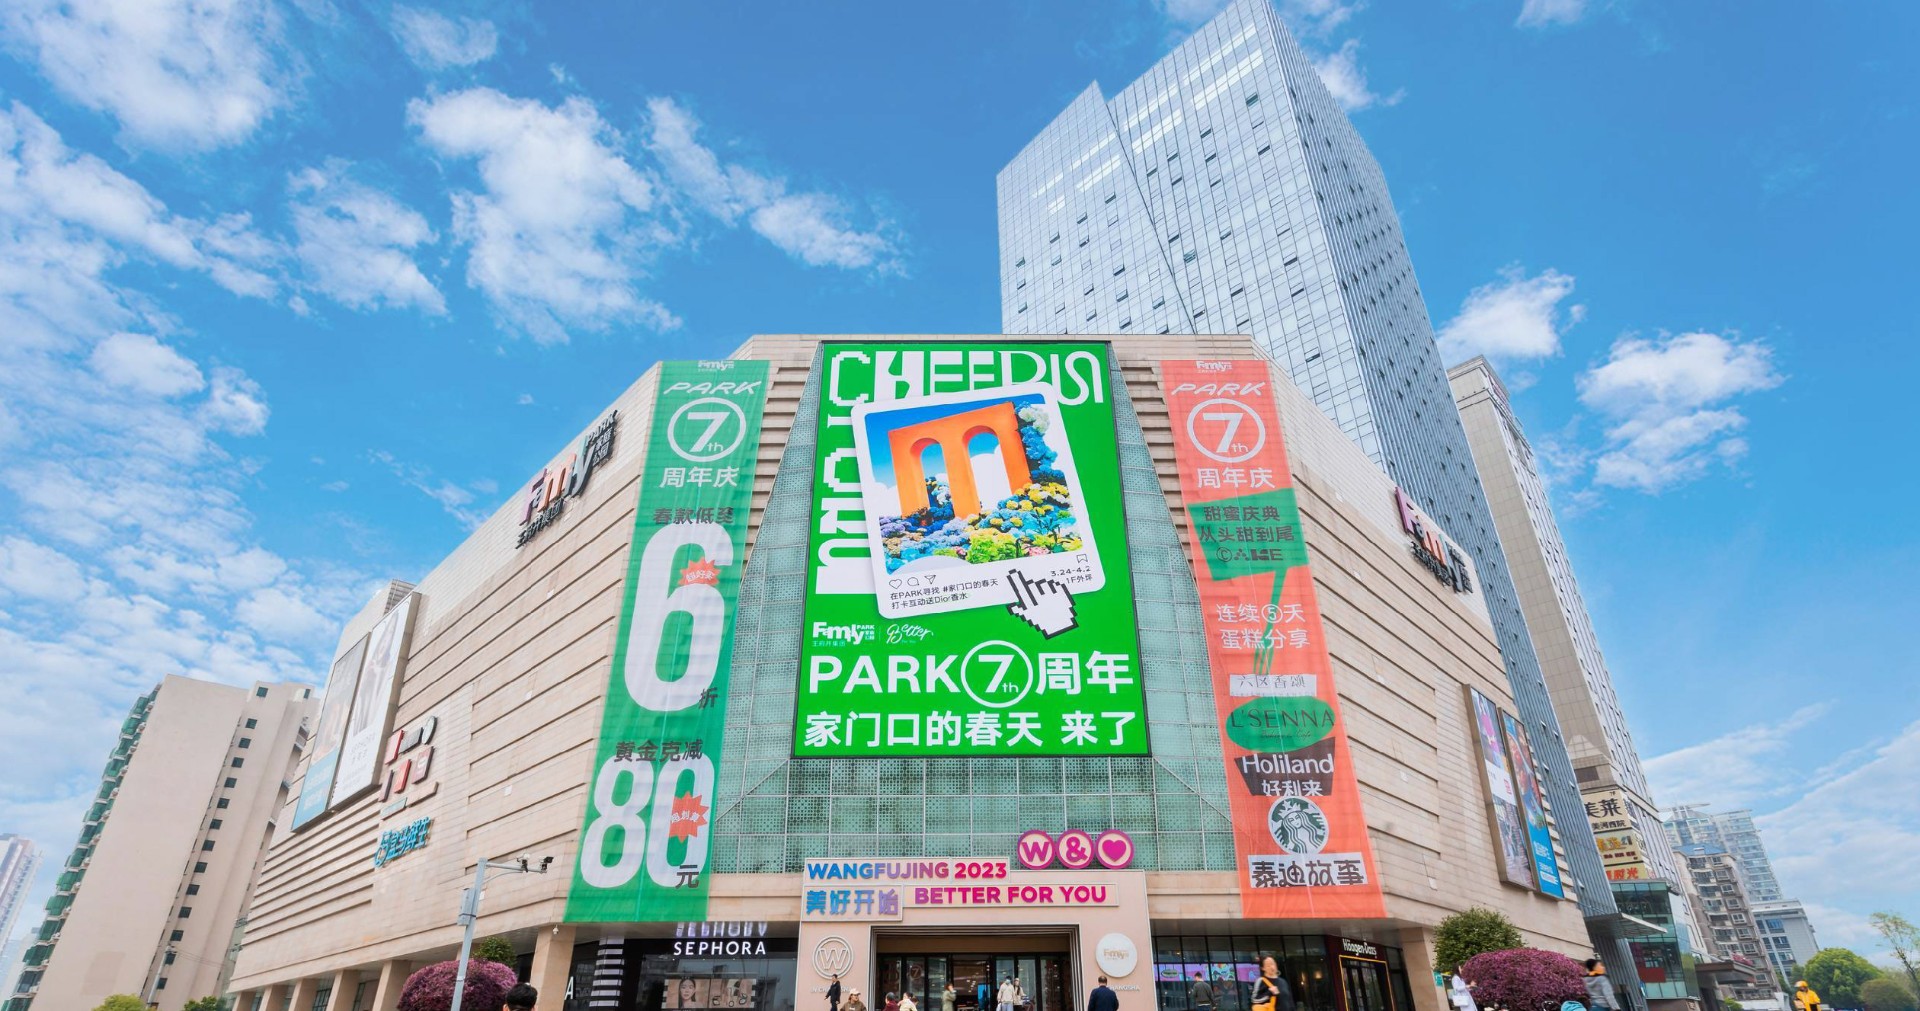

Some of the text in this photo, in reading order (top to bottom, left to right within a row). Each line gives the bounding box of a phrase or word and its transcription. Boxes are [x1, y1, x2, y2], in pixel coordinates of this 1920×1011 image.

[663, 381, 761, 395] PARK
[1171, 381, 1265, 395] PARK
[687, 412, 730, 453] 7th
[1203, 413, 1249, 453] 7th
[659, 467, 739, 488] 周年庆
[1197, 467, 1275, 489] 周年庆
[1203, 506, 1280, 522] 甜蜜庆典
[1198, 526, 1294, 542] 从头甜到尾
[1050, 566, 1091, 577] 3.24-4.2
[890, 578, 999, 600] 在PARK寻找 #家门口的春天
[891, 591, 968, 609] 打卡互动送Dior香水
[1220, 628, 1311, 650] 蛋糕分享
[804, 710, 1136, 748] 家门口的春天 来了
[1230, 708, 1335, 729] L'SENNA
[614, 739, 703, 763] 黄金克减
[1242, 753, 1335, 775] Holiland
[1261, 779, 1323, 796] 好利来
[807, 862, 1008, 880] WANGFUJING 2023
[1251, 859, 1364, 887] 泰迪故事
[806, 888, 899, 916] 美好开始
[915, 886, 1107, 905] BETTER FOR YOU
[673, 941, 767, 956] SEPHORA
